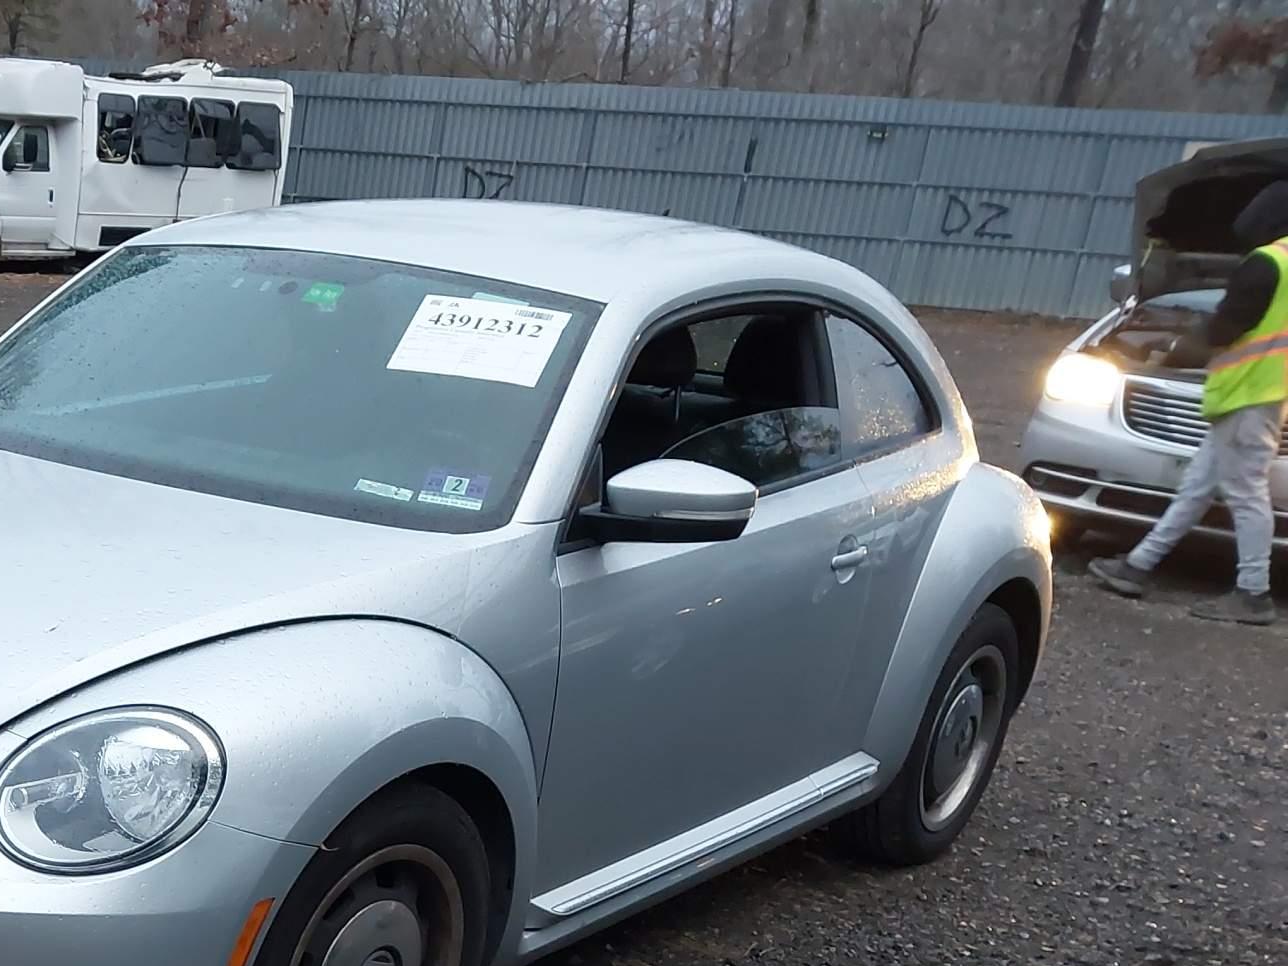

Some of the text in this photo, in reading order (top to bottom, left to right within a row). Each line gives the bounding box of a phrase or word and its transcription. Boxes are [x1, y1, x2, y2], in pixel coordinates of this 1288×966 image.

[941, 195, 1013, 240] DZ
[428, 312, 544, 338] 43912312
[451, 479, 463, 492] 2
